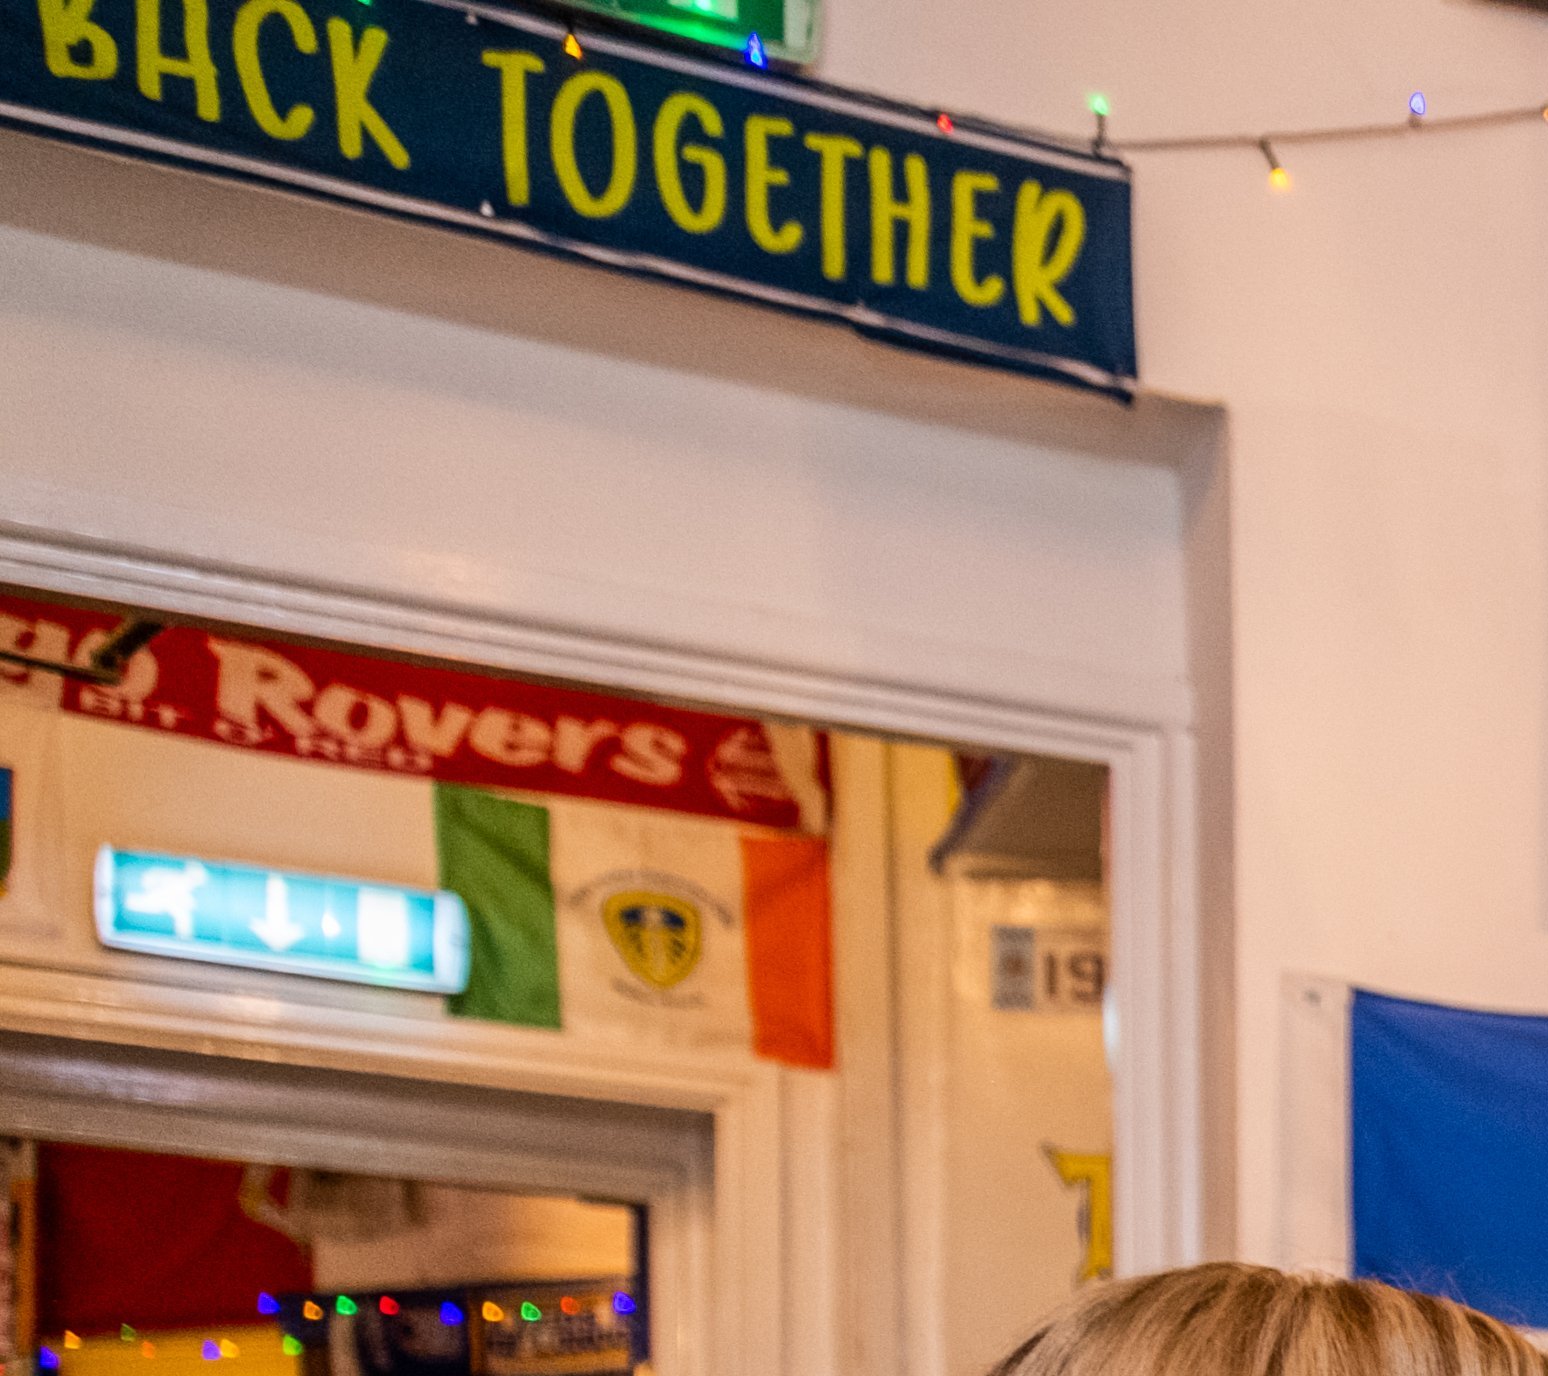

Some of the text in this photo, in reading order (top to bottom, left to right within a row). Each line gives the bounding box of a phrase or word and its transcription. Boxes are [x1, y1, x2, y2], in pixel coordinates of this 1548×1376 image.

[37, 0, 1086, 328] BACK TOGETHER
[206, 636, 690, 787] Rovers
